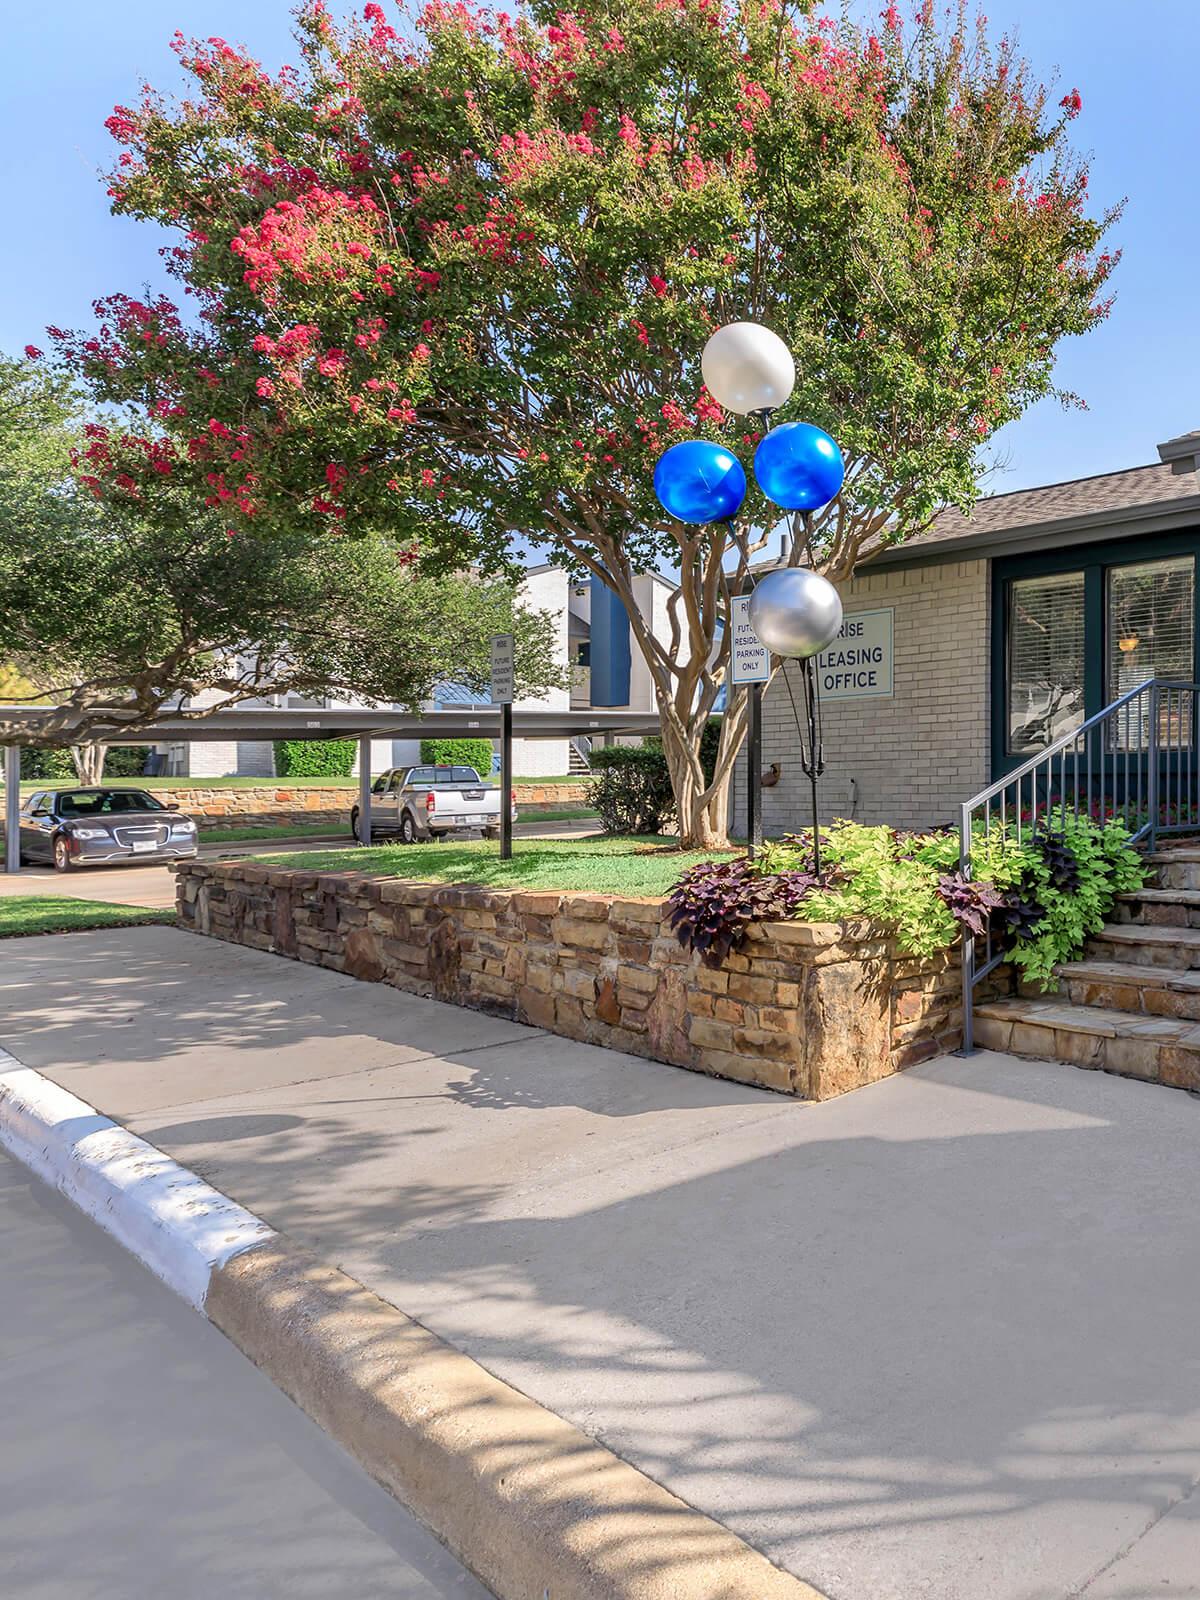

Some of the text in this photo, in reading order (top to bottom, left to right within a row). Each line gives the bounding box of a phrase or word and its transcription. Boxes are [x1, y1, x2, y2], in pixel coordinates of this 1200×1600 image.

[738, 625, 752, 633] FUT
[735, 637, 759, 646] RESIDE
[736, 648, 765, 659] PARKING
[819, 647, 883, 669] LEASING
[742, 662, 759, 671] ONLY
[824, 671, 877, 691] OFFICE
